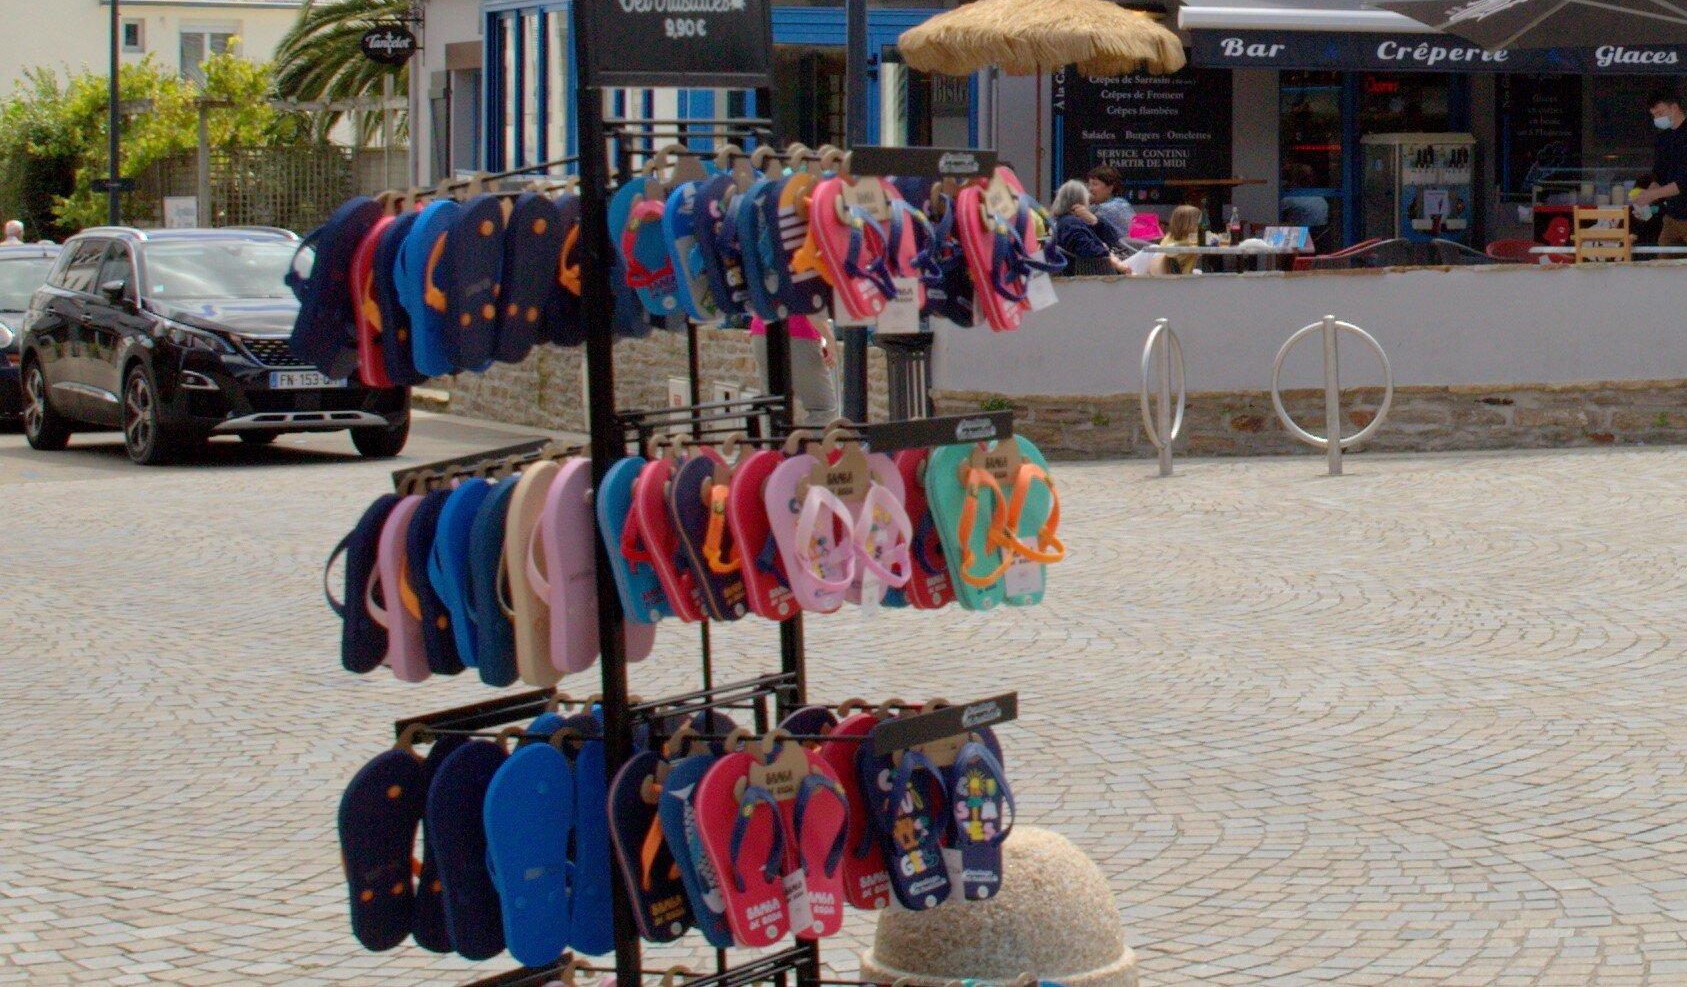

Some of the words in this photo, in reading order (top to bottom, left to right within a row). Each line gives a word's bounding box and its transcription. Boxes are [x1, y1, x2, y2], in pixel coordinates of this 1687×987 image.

[1220, 37, 1286, 58] Bar
[1377, 40, 1510, 65] Crêperie
[1595, 45, 1680, 67] Glaces
[1100, 89, 1132, 101] Crêpes
[1082, 130, 1116, 139] Salades
[1125, 130, 1160, 141] Burgers
[1097, 149, 1138, 158] SERVICE
[1142, 149, 1190, 158] CONTINU
[1110, 159, 1145, 168] PARTIR
[1146, 159, 1161, 168] DE
[1163, 159, 1187, 168] MIDI
